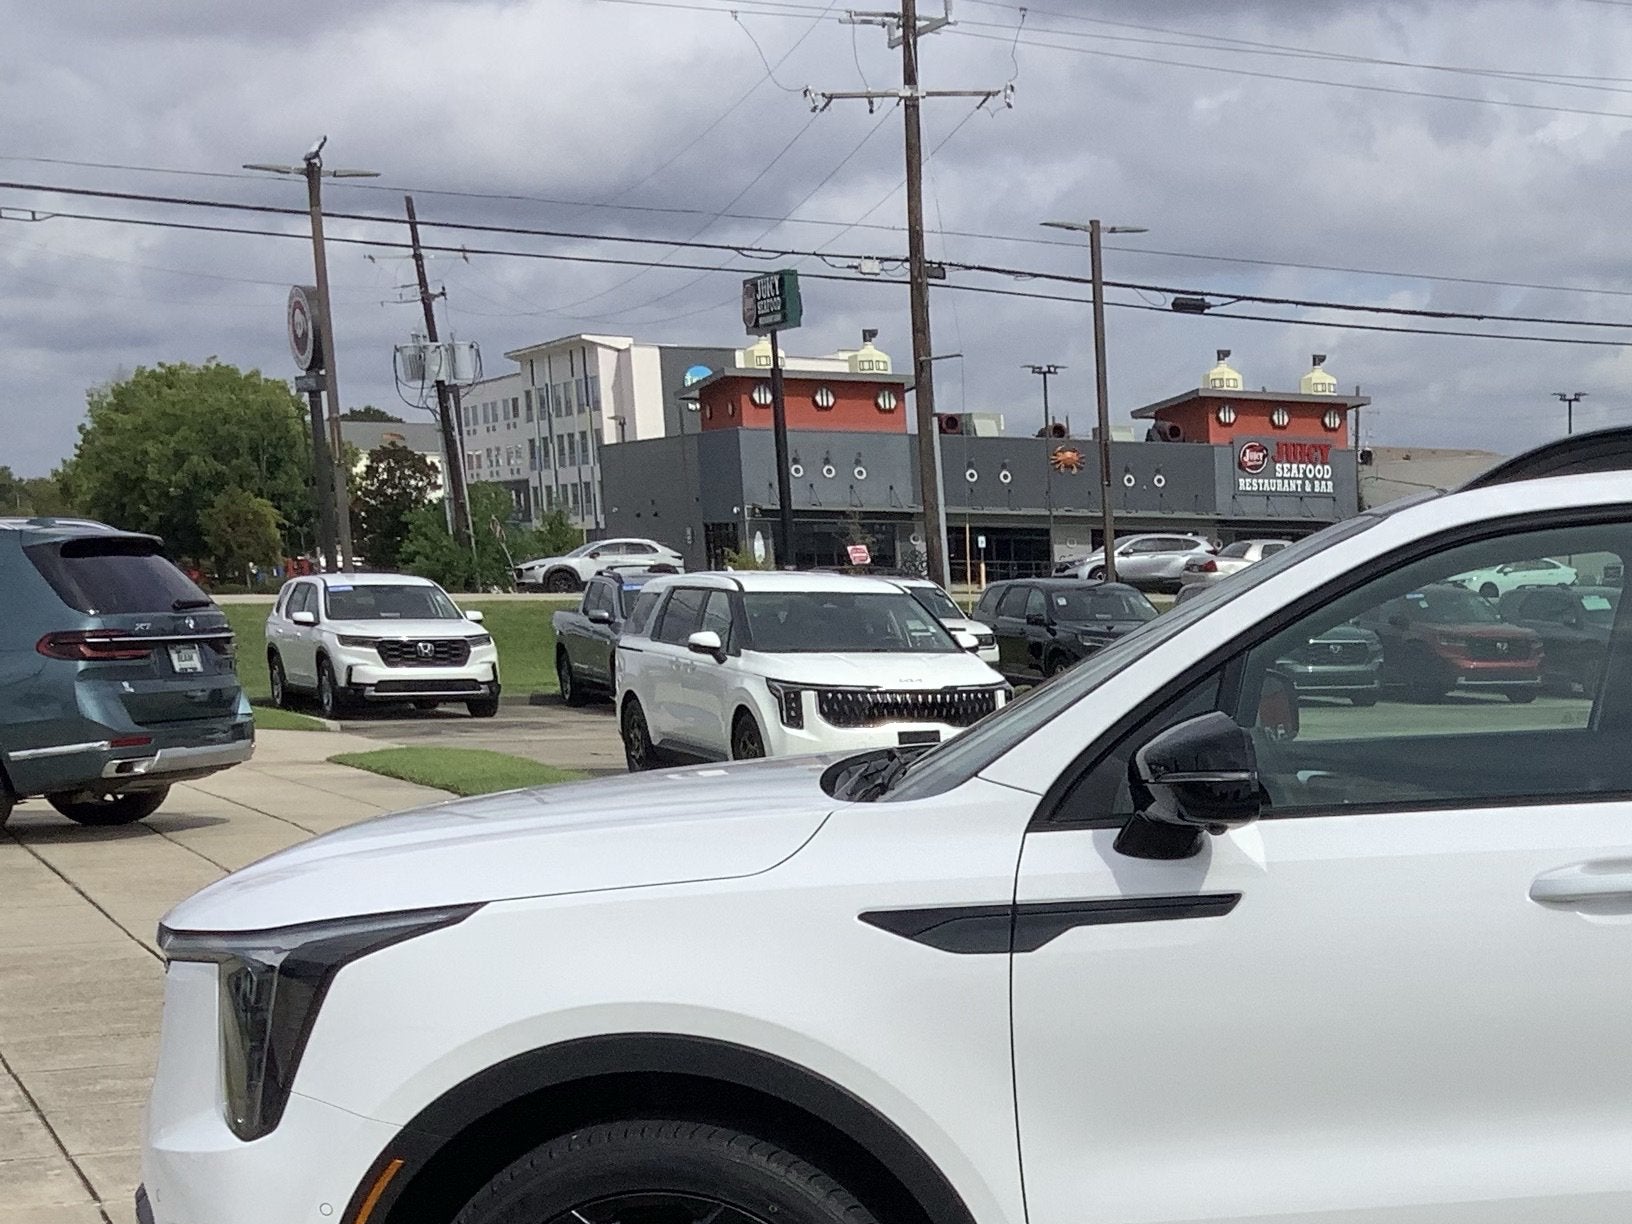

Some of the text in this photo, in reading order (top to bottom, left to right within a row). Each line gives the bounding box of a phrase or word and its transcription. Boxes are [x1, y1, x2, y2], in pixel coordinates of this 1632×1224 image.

[757, 274, 780, 300] JUICY
[1272, 442, 1331, 463] JUICY
[1275, 463, 1332, 479] SEAFOOD
[1238, 478, 1334, 493] RESTAURANT & BAR
